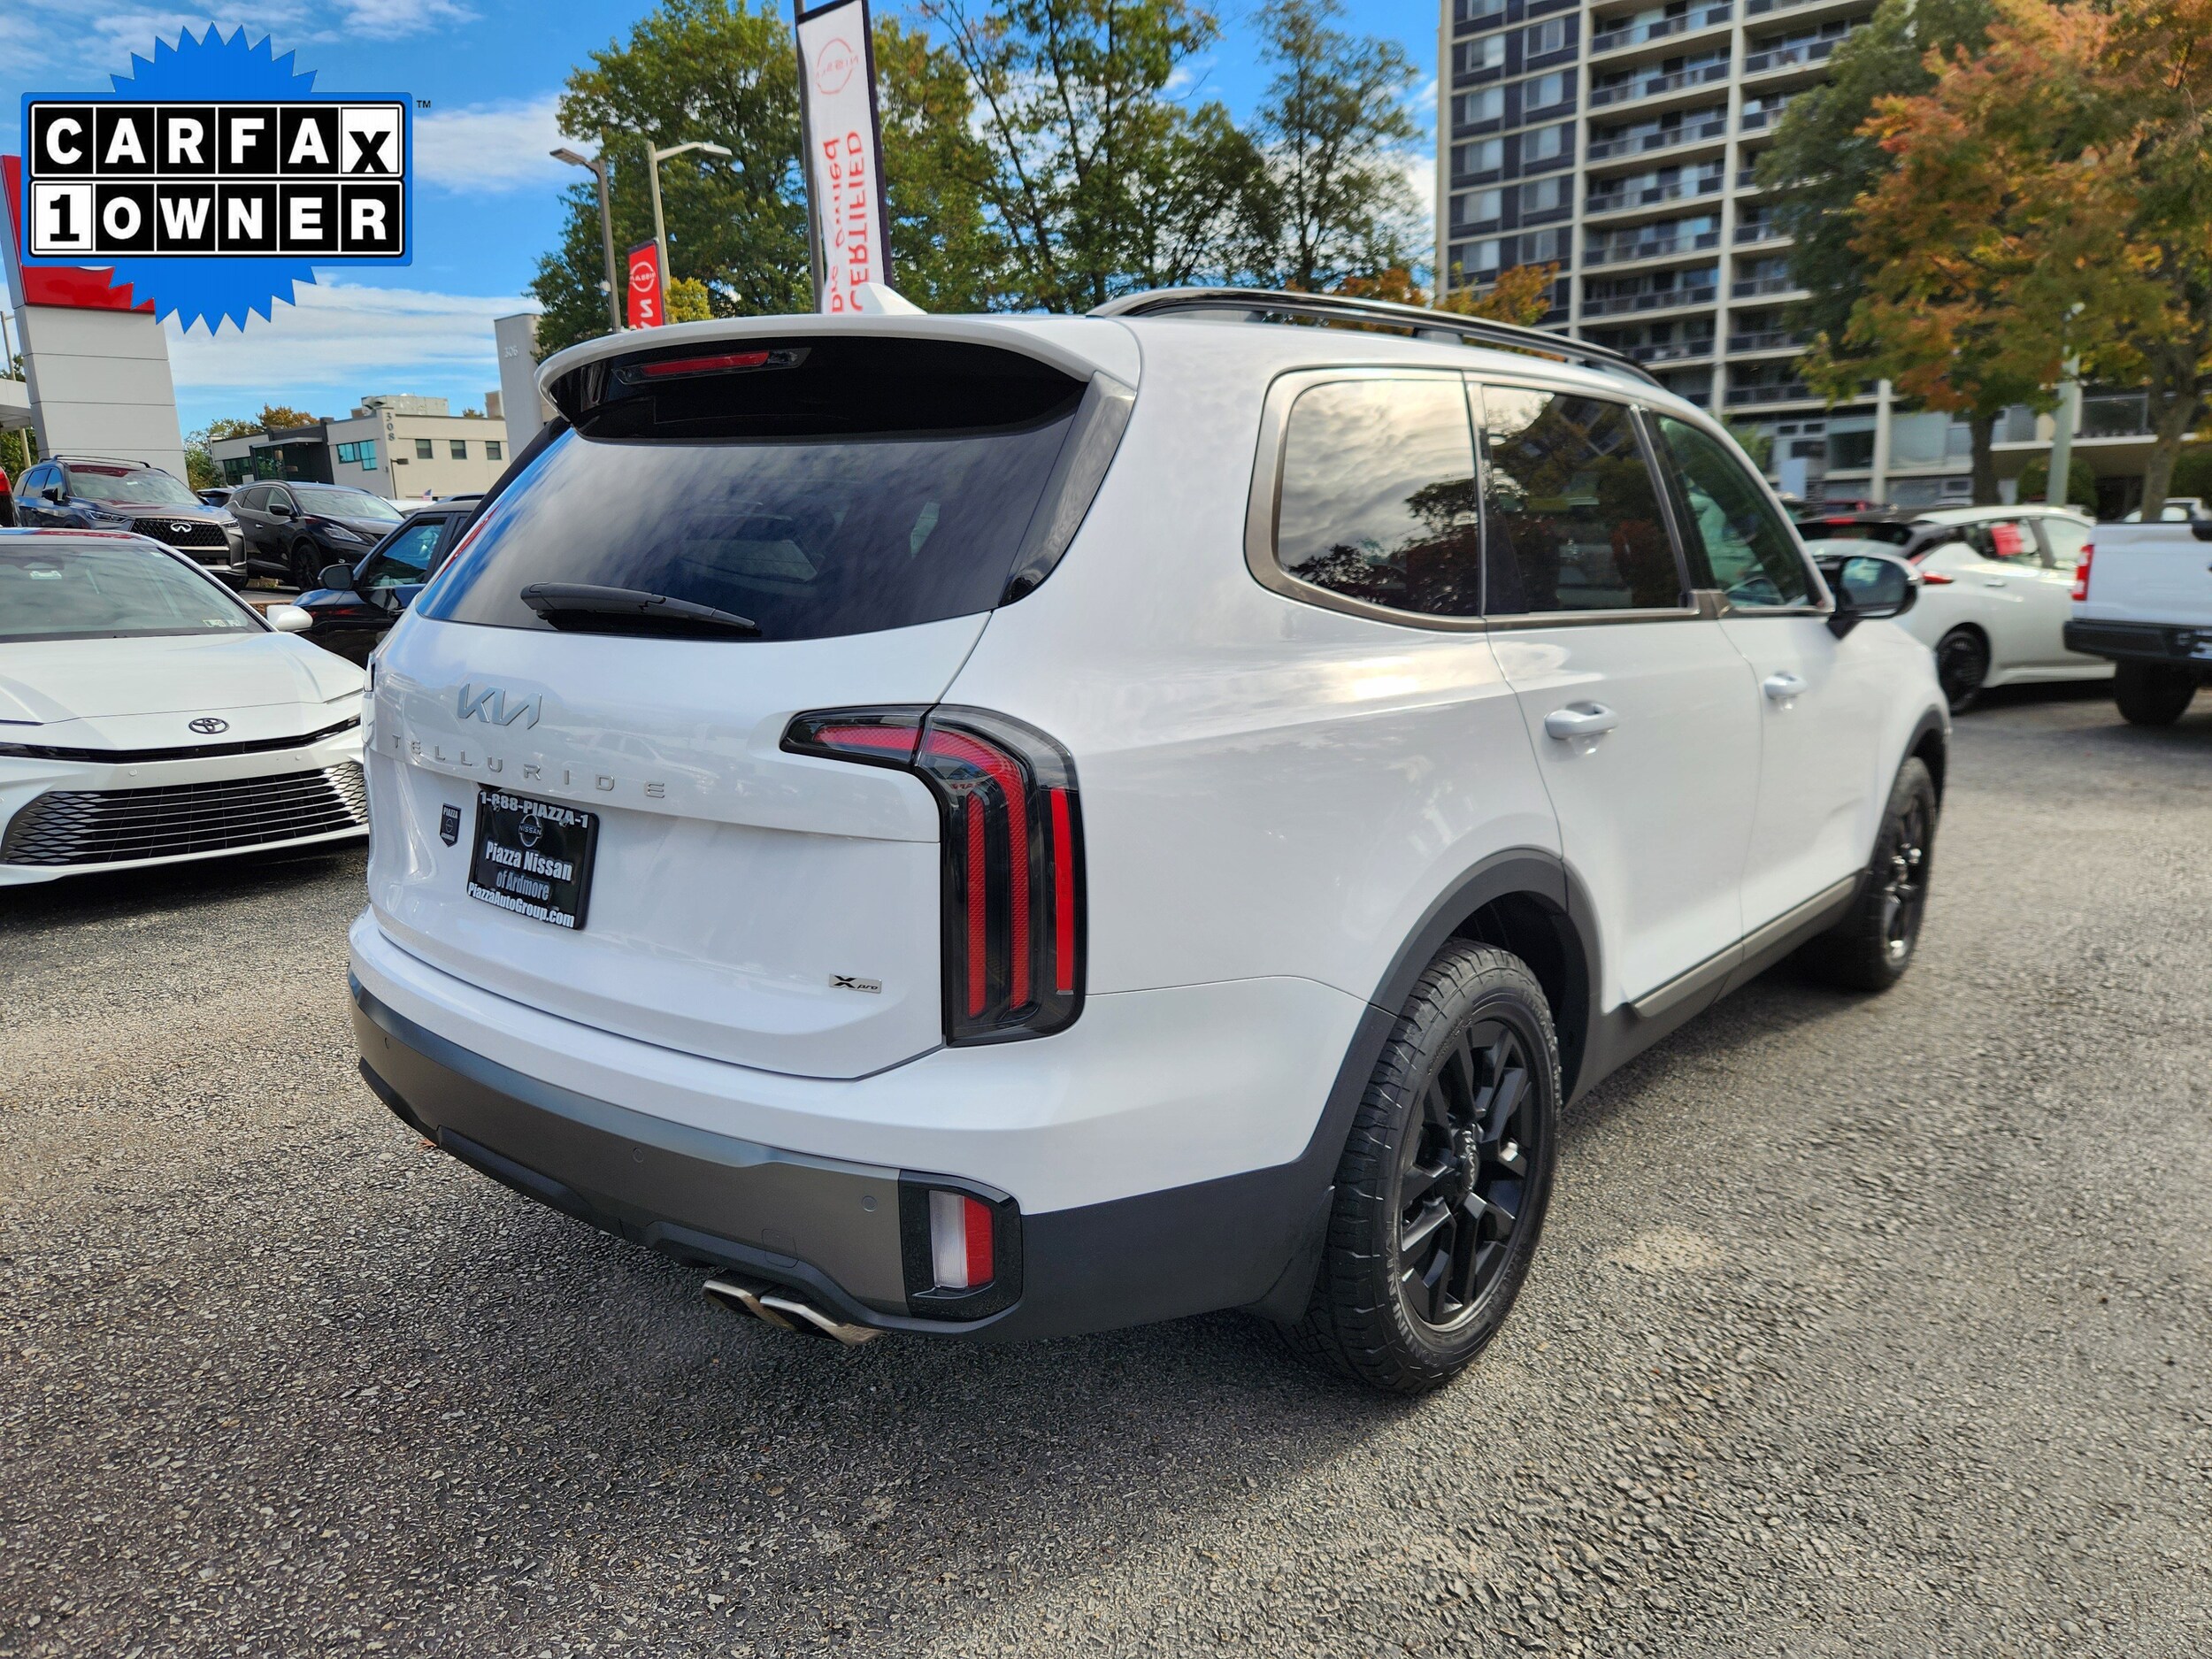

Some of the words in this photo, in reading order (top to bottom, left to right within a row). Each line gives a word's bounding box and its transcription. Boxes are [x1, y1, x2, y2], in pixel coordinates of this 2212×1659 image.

[457, 683, 543, 731] KIA
[392, 733, 666, 800] TELLURIDE
[480, 791, 589, 829] 1-888-PIAZZA-1
[518, 824, 542, 836] NISSAN
[485, 841, 522, 869] Piazza
[523, 850, 573, 882] Nissan
[468, 881, 576, 929] PiazzaAutoGroup.com
[495, 869, 508, 887] of
[506, 871, 550, 902] Ardmore
